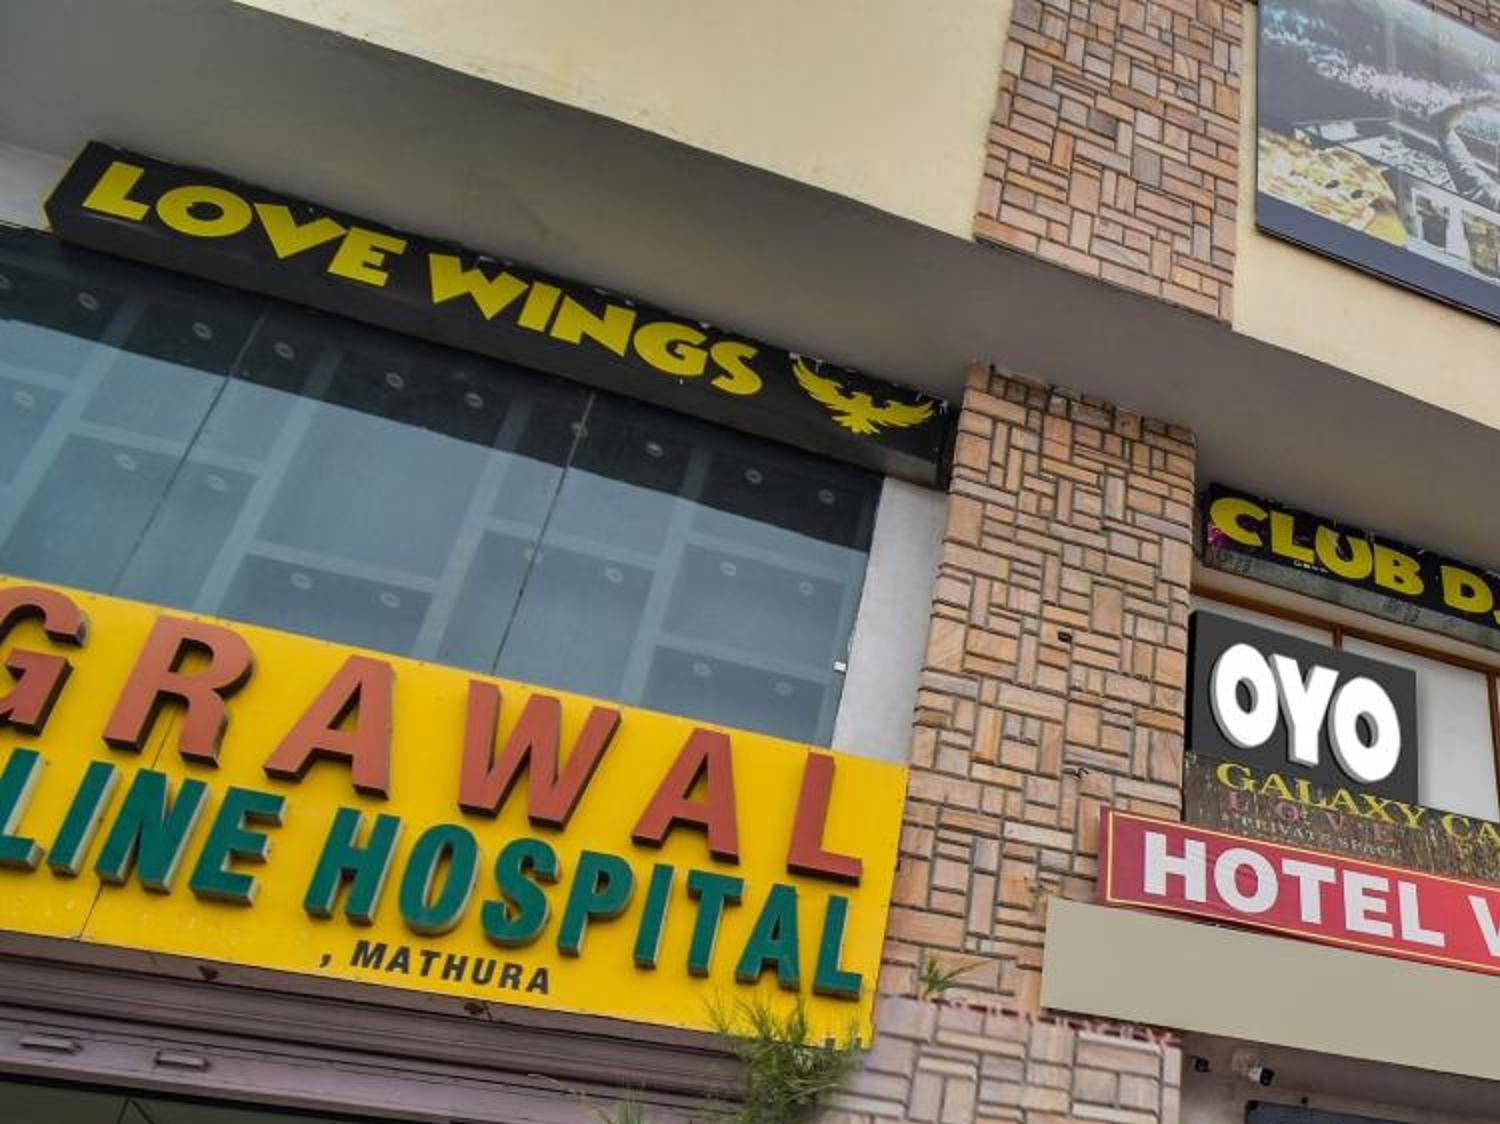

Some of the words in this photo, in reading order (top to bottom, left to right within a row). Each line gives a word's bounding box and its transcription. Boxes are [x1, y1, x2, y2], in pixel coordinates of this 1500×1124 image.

[82, 161, 406, 286] LOVE
[428, 252, 763, 396] WINGS
[1210, 497, 1425, 596] CLUB
[0, 585, 864, 885] GRAWAL
[1209, 641, 1402, 785] OYO
[1216, 762, 1427, 830] GALAXY
[303, 806, 866, 998] HOSPITAL
[1142, 830, 1446, 948] HOTEL
[350, 938, 550, 995] MATHURA
